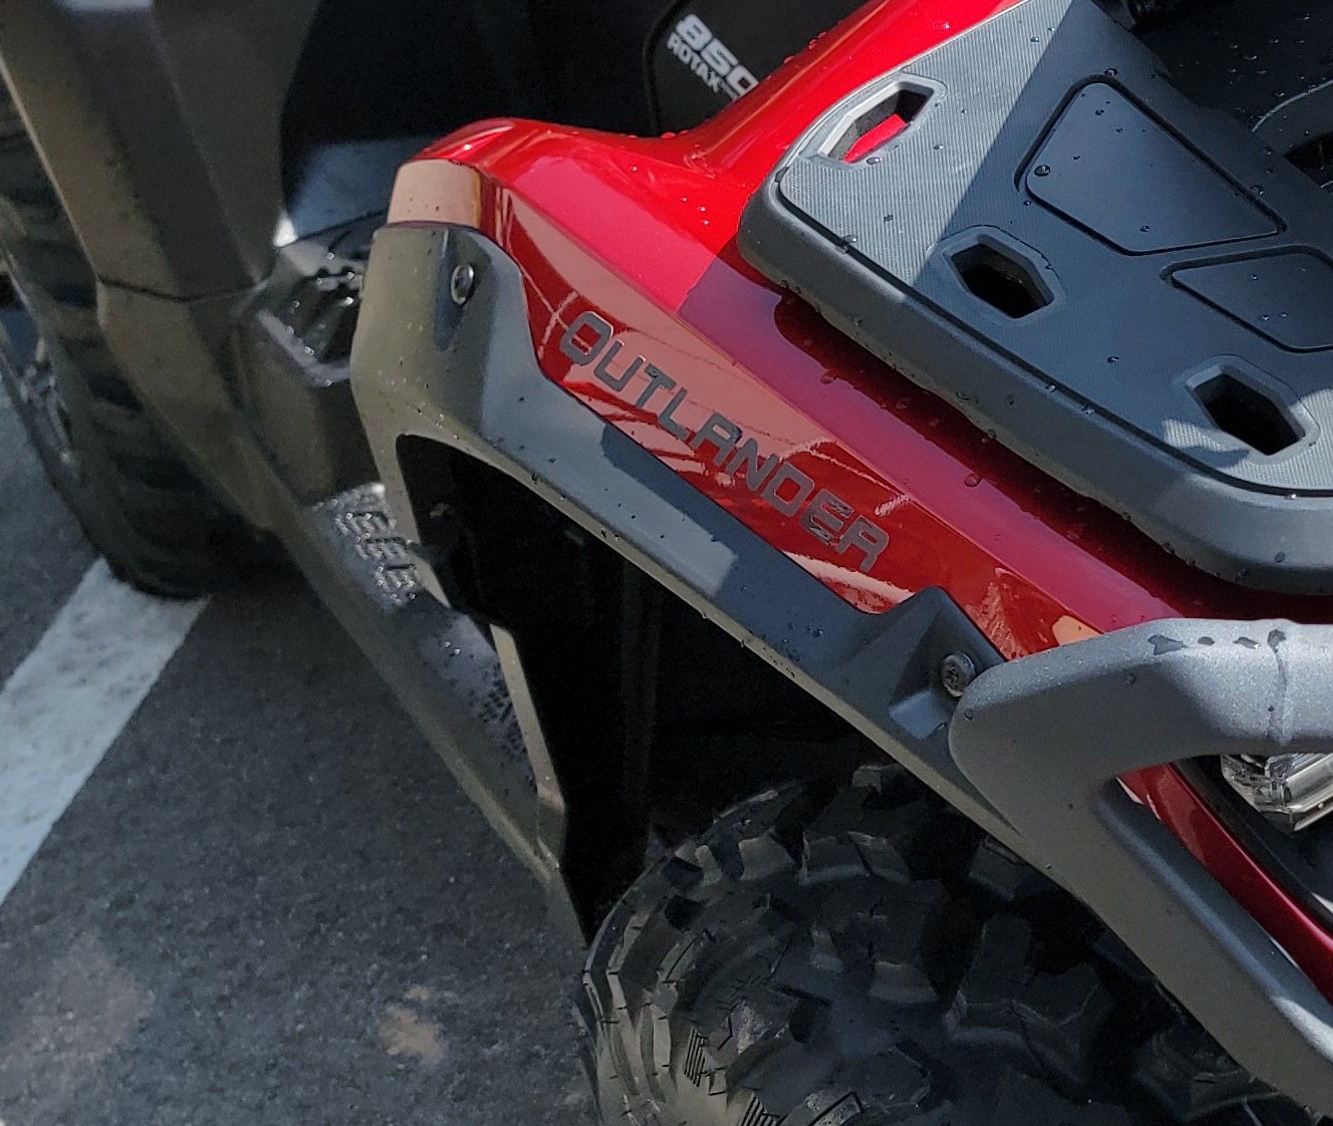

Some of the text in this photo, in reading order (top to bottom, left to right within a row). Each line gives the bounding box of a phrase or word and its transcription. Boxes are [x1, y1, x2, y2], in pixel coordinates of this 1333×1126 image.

[666, 31, 721, 93] ROTAX
[675, 13, 760, 97] 850
[560, 311, 890, 573] OUTLANDER
